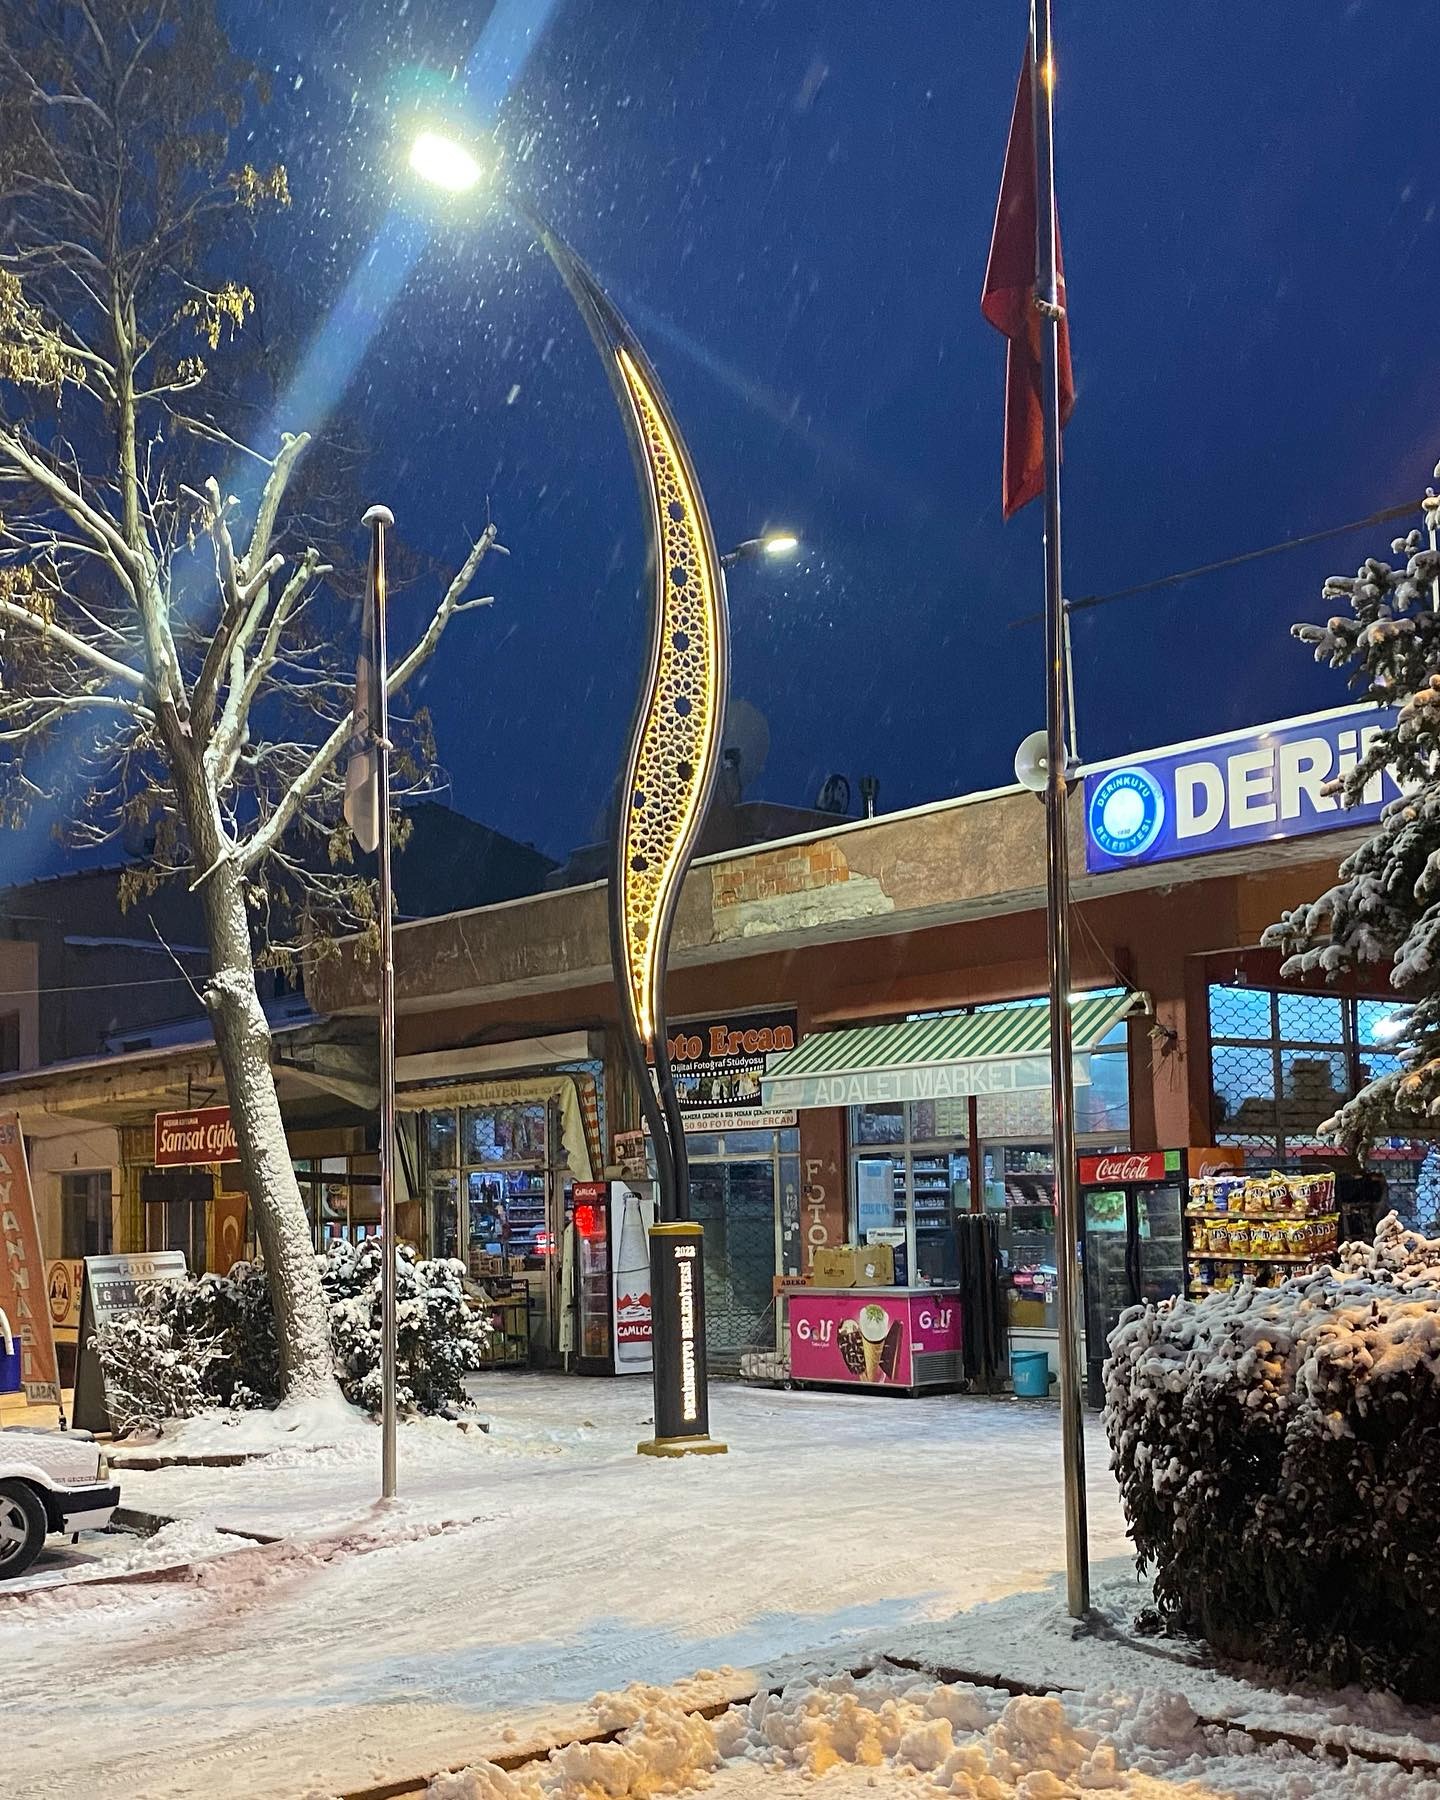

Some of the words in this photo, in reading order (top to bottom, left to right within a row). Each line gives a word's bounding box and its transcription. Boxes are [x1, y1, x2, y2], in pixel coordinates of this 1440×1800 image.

[1097, 777, 1151, 807] DERİNKUYU
[709, 1025, 795, 1057] Ercan
[671, 1063, 693, 1073] Dijital
[693, 1059, 726, 1071] Fotoğraf
[727, 1056, 764, 1070] Stüdyosu
[814, 1070, 907, 1105] ADALET
[911, 1060, 1023, 1098] MARKET
[710, 1118, 735, 1129] FOTO
[737, 1114, 761, 1128] Ömer
[763, 1116, 794, 1126] ERCAN
[160, 1126, 205, 1152] Samsat
[118, 1261, 155, 1275] FOTO
